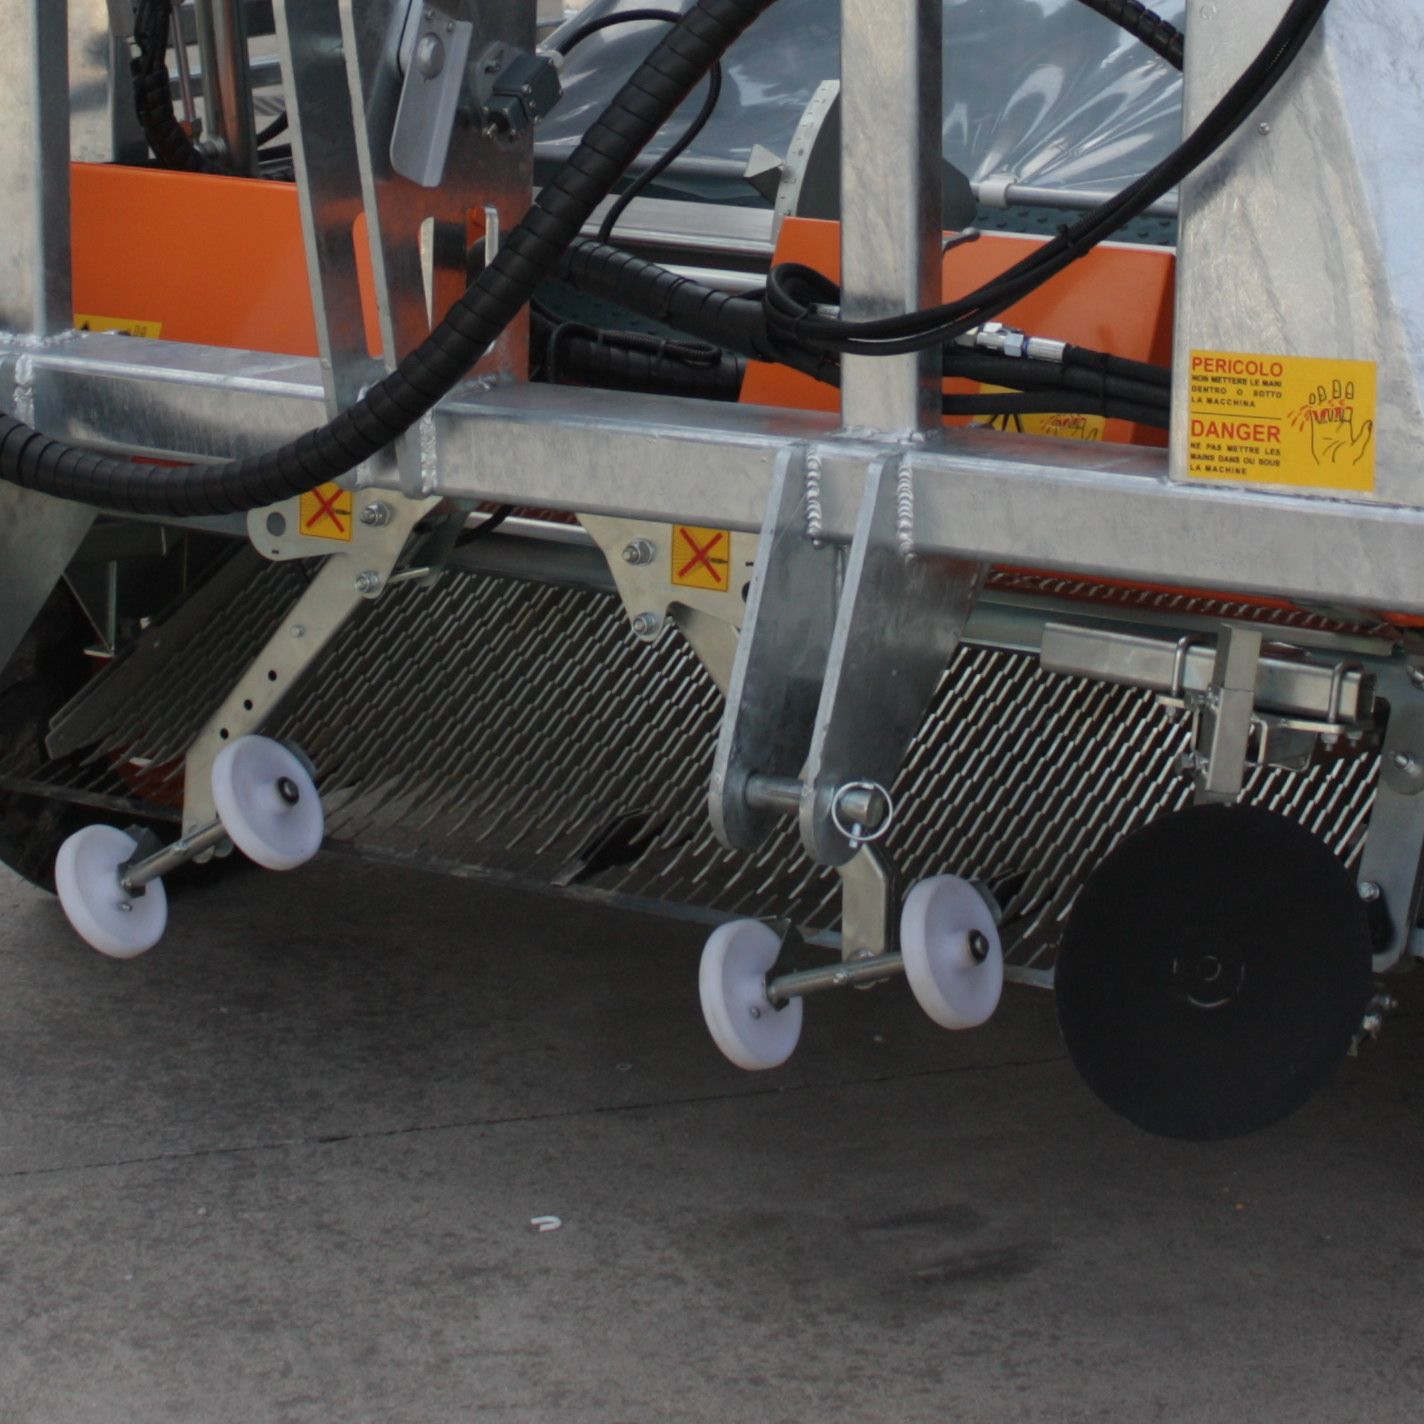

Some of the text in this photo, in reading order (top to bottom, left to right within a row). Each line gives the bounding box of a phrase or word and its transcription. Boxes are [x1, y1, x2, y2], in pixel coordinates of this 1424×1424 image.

[1192, 357, 1283, 377] PERICOLO
[1191, 385, 1227, 394] DENTRO
[1253, 389, 1282, 399] SOTTO
[1206, 397, 1256, 407] MACCHINA
[1191, 419, 1280, 443] DANGER
[1206, 443, 1221, 451] PAS
[1227, 445, 1260, 454] METTRE
[1265, 448, 1280, 456] LES
[1205, 465, 1247, 475] MACHINE
